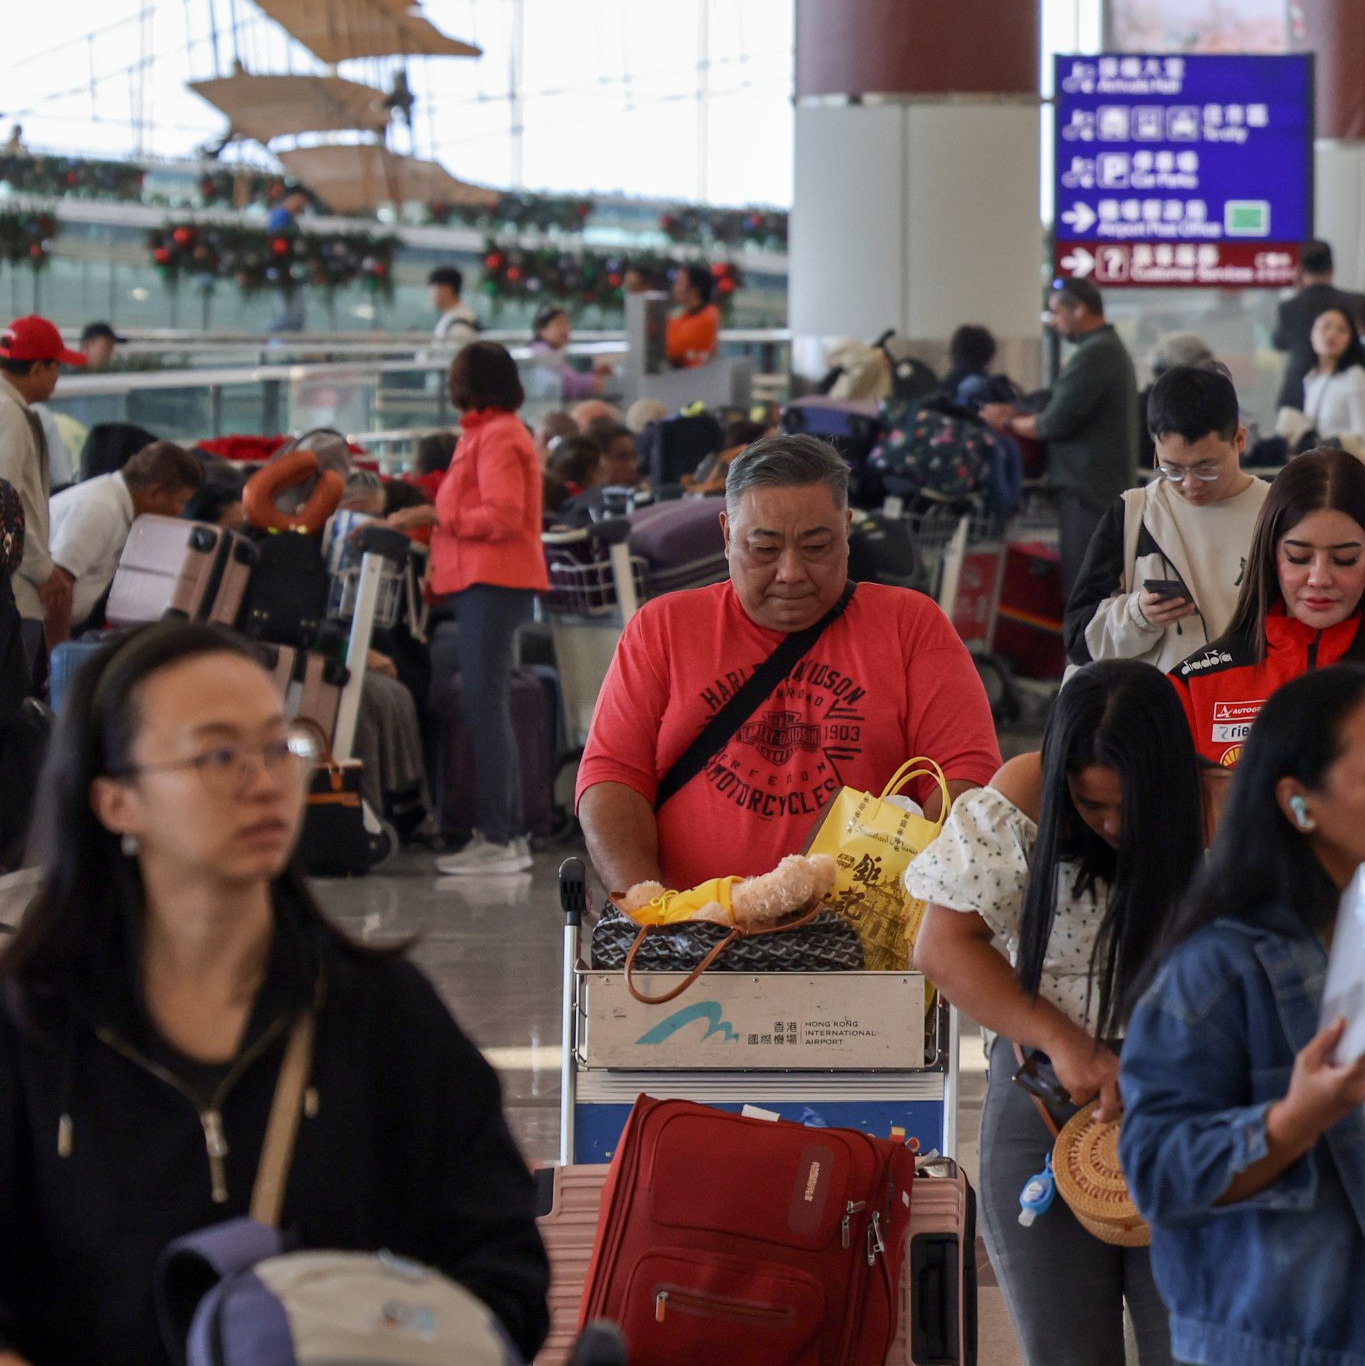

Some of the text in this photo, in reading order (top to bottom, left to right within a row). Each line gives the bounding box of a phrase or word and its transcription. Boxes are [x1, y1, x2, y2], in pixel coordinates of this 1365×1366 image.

[1181, 649, 1234, 675] diadora
[825, 725, 861, 742] 1903
[1231, 725, 1252, 738] rie
[716, 753, 827, 786] FREEDOM
[706, 765, 837, 817] MOTORCYCLES
[774, 1021, 798, 1033] 香港
[833, 1020, 859, 1028] KONG
[747, 1033, 798, 1045] 國際機場
